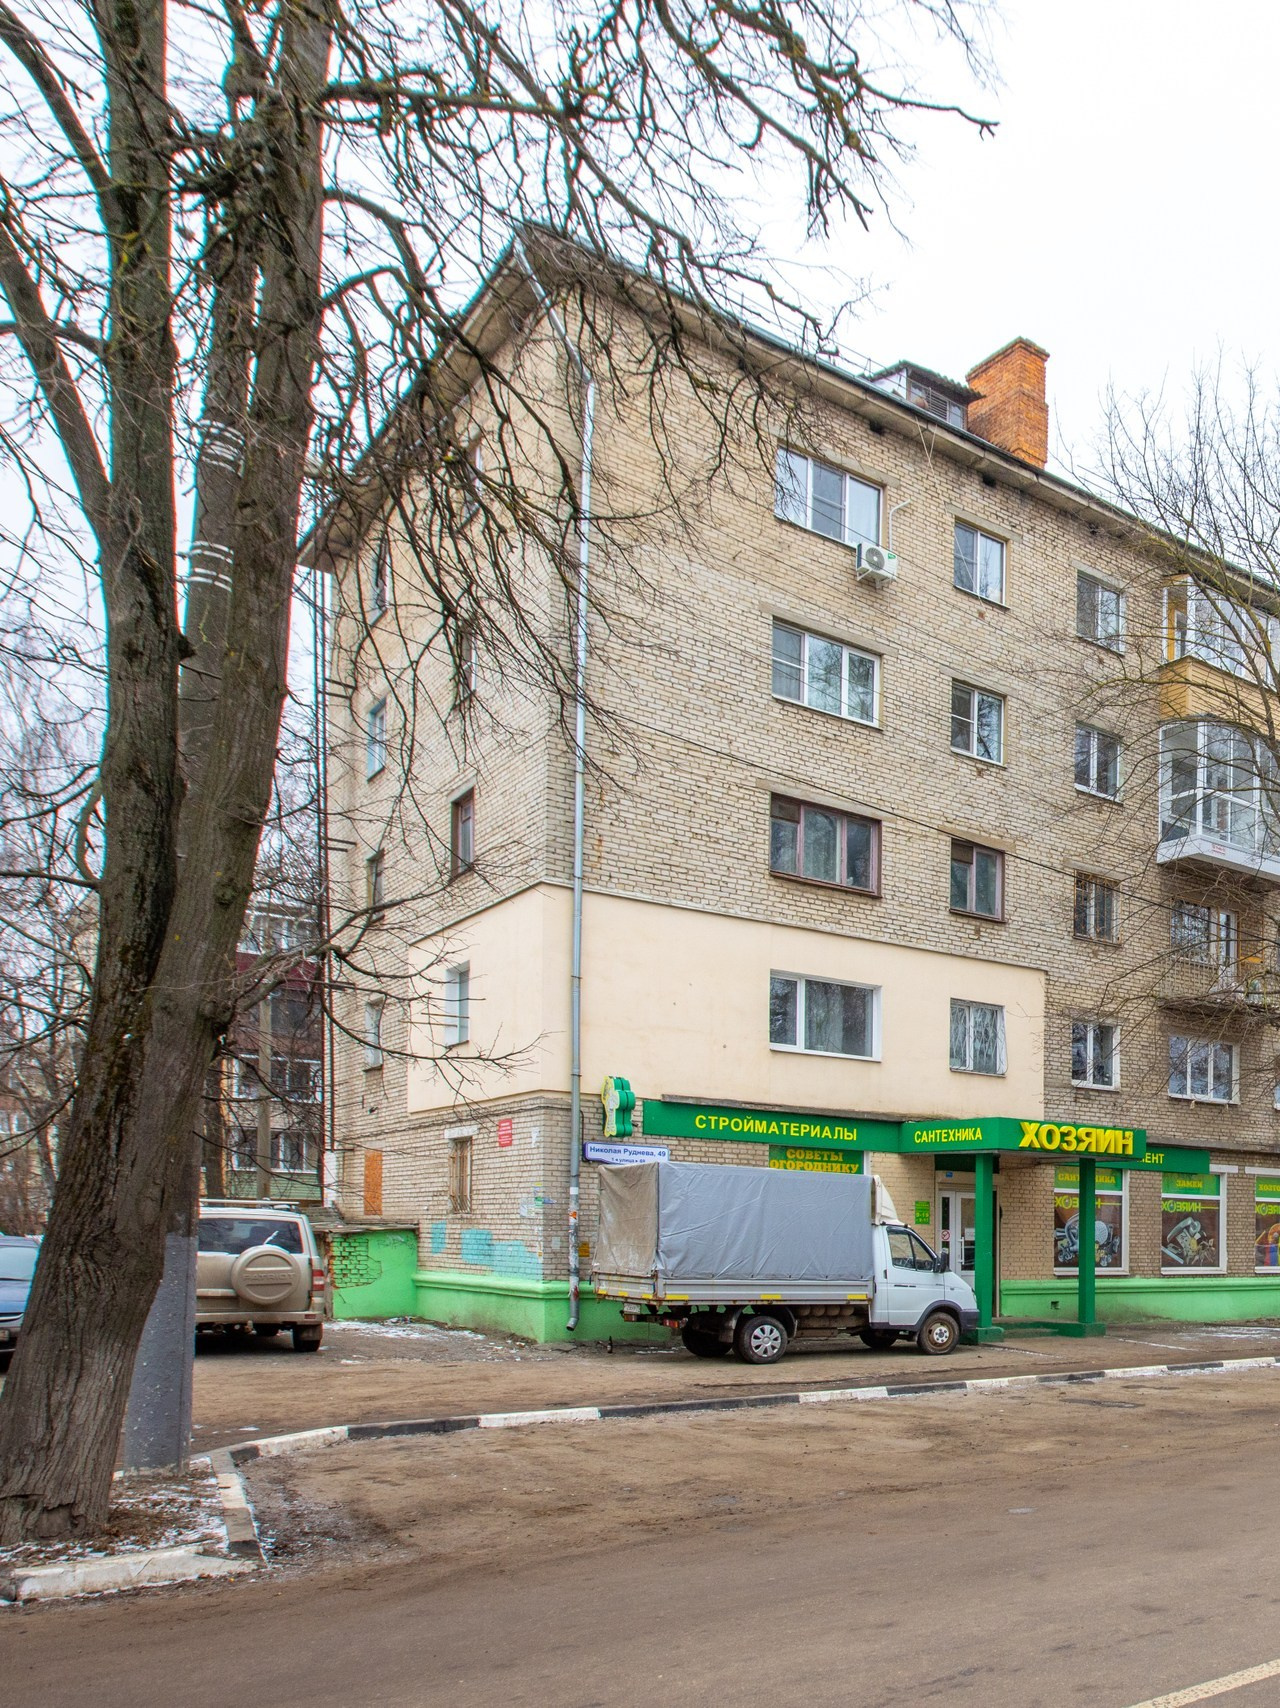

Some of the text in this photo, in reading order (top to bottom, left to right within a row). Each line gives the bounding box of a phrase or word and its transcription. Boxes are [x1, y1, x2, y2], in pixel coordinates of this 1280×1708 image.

[695, 1115, 857, 1141] СТРОЙМАТЕРИАЛЫ
[914, 1128, 982, 1144] САНТЕХНИКА
[1019, 1121, 1133, 1155] ХОЗЯИН
[589, 1146, 621, 1154] Николая
[623, 1148, 656, 1157] Руднева,
[786, 1149, 844, 1161] СОВЕТЫ
[1141, 1152, 1165, 1164] ЕНТ
[769, 1160, 859, 1173] ОГОРОДНИКУ
[1058, 1173, 1116, 1184] САНТИКА
[1162, 1200, 1202, 1212] ХОЗЯИН
[243, 1272, 295, 1281] PATRIOT
